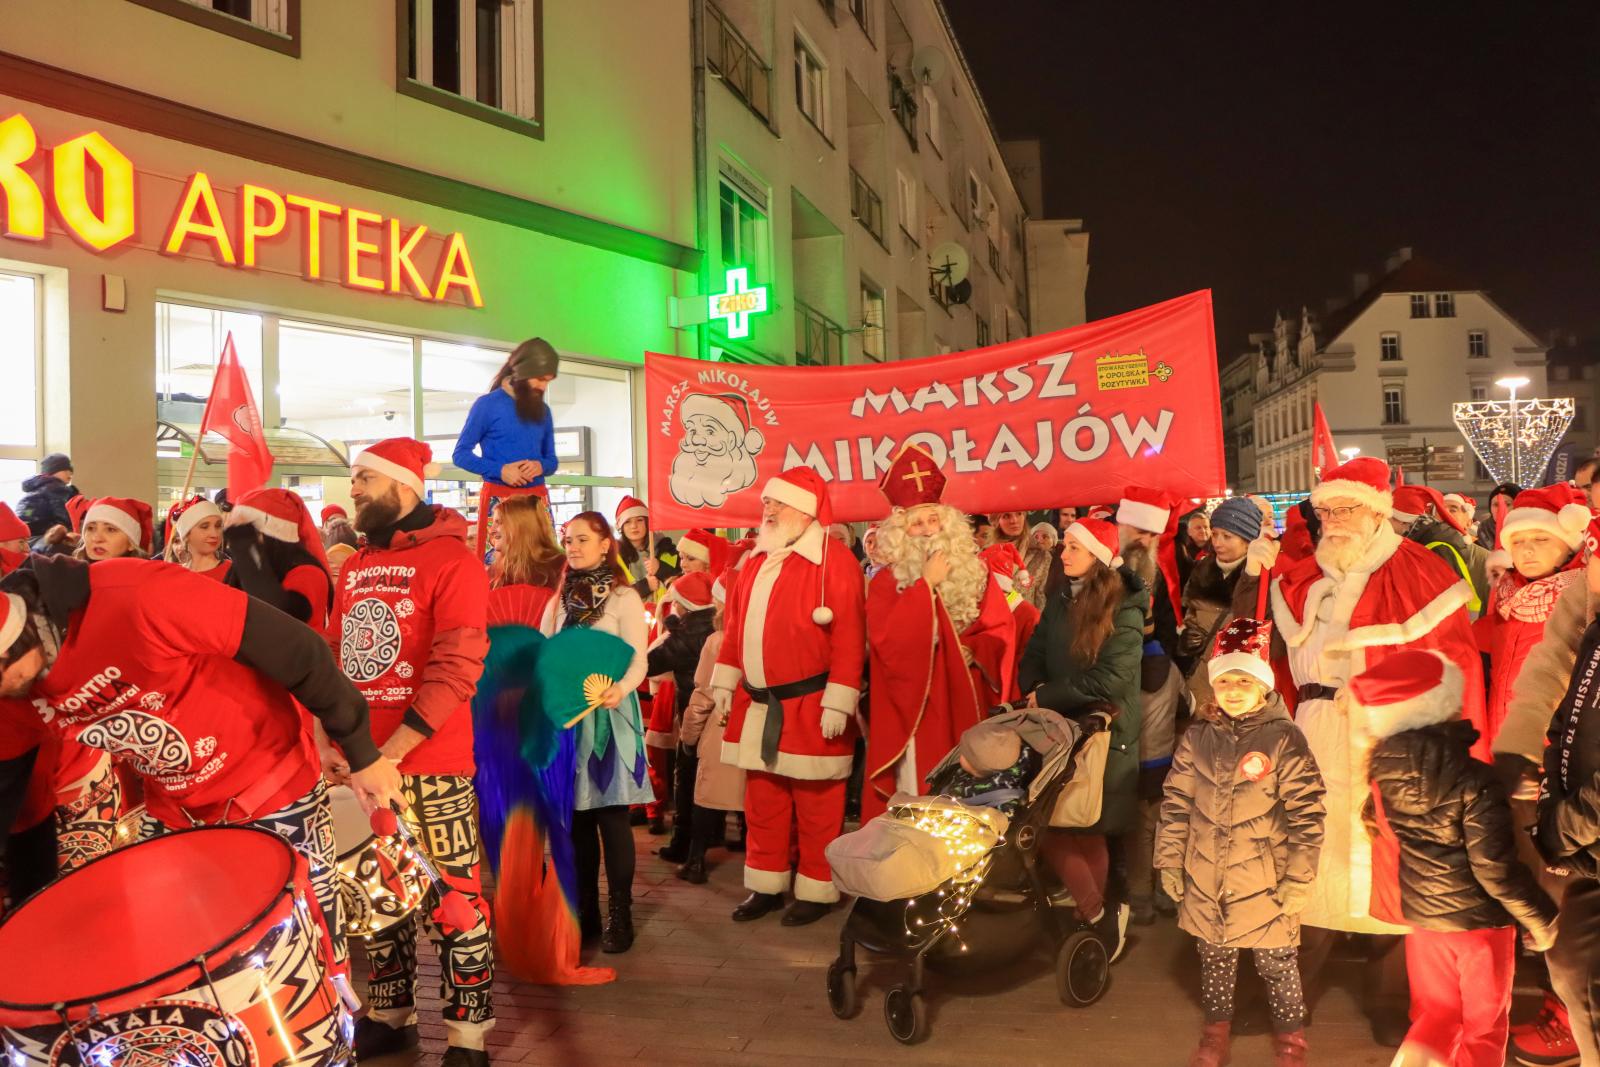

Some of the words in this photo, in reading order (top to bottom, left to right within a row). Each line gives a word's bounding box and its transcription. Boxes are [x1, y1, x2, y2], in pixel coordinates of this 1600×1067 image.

[161, 171, 484, 308] APTEKA
[1105, 369, 1140, 379] OPOLSKA
[1101, 378, 1147, 388] POZYTYWKA
[660, 380, 690, 436] MARSZ
[376, 584, 411, 595] Central
[386, 687, 413, 695] 2022
[1566, 728, 1576, 745] TO
[71, 1008, 185, 1053] BATALA
